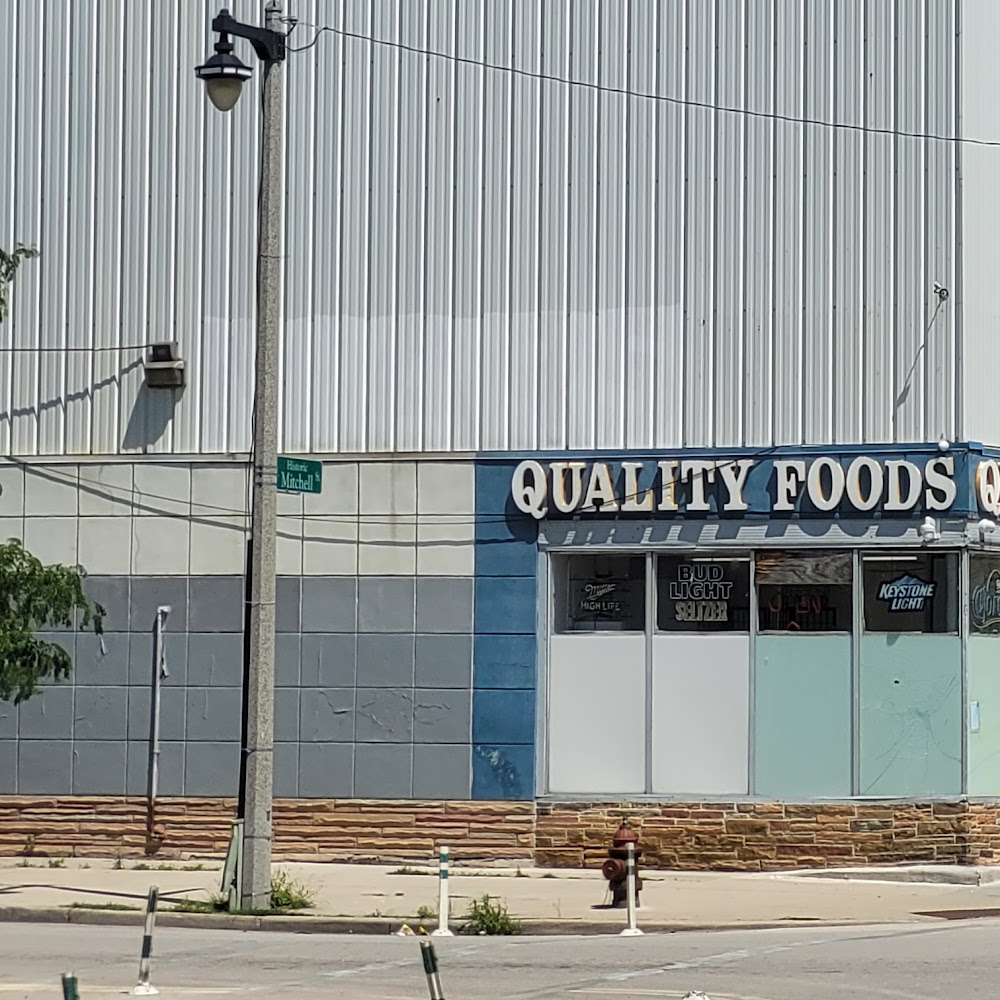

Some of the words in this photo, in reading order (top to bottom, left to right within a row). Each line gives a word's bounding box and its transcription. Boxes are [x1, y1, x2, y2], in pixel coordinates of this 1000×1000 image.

[280, 470, 314, 491] Mitchell
[511, 459, 755, 520] QUALITY
[772, 455, 957, 512] FOODS
[678, 564, 724, 582] BUD
[669, 581, 734, 600] LIGHT
[879, 584, 936, 600] KEYSTONE
[580, 601, 601, 611] HIGH
[602, 602, 621, 612] LIFE
[675, 600, 729, 622] SELTZER
[891, 598, 924, 611] LIGHT
